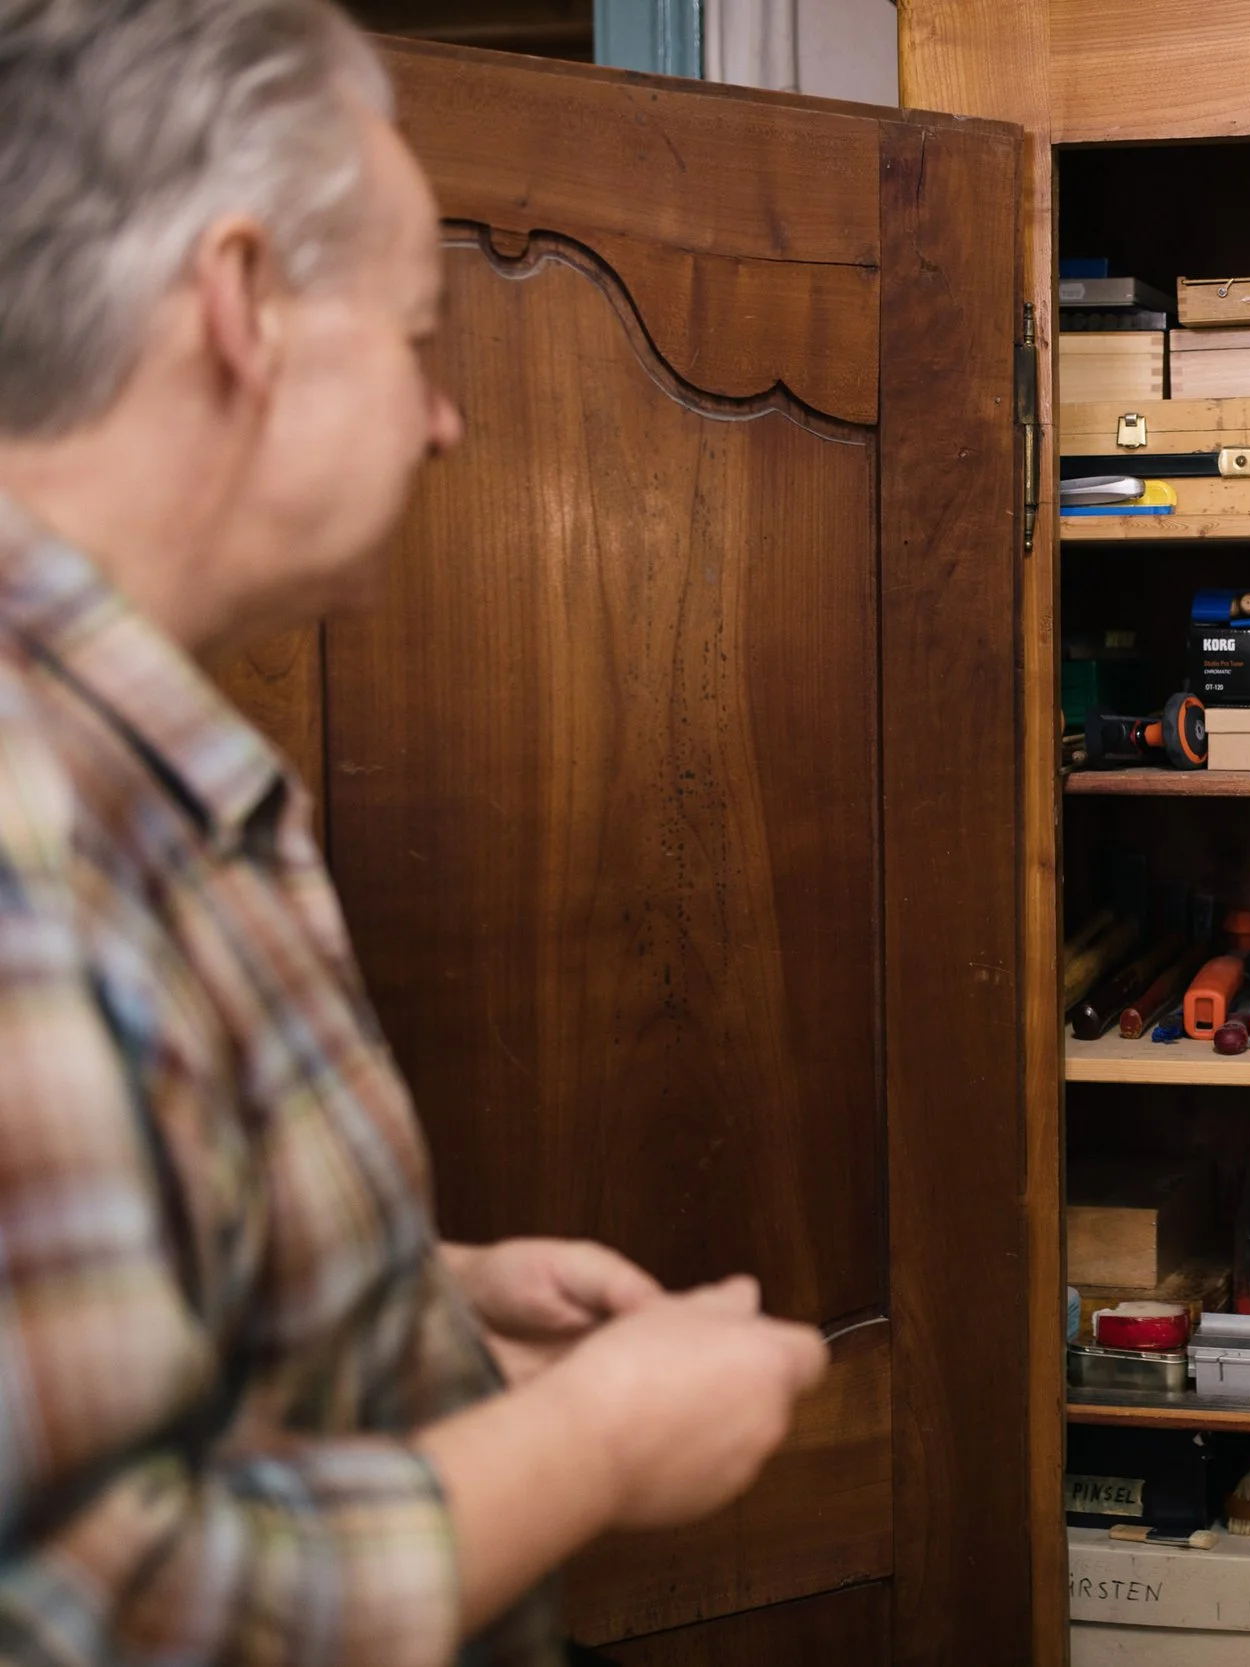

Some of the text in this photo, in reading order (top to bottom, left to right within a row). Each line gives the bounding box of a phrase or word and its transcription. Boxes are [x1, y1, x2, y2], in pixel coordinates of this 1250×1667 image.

[1203, 638, 1236, 652] KORG
[1205, 683, 1224, 691] OT-120
[1072, 1481, 1136, 1504] PINSEL
